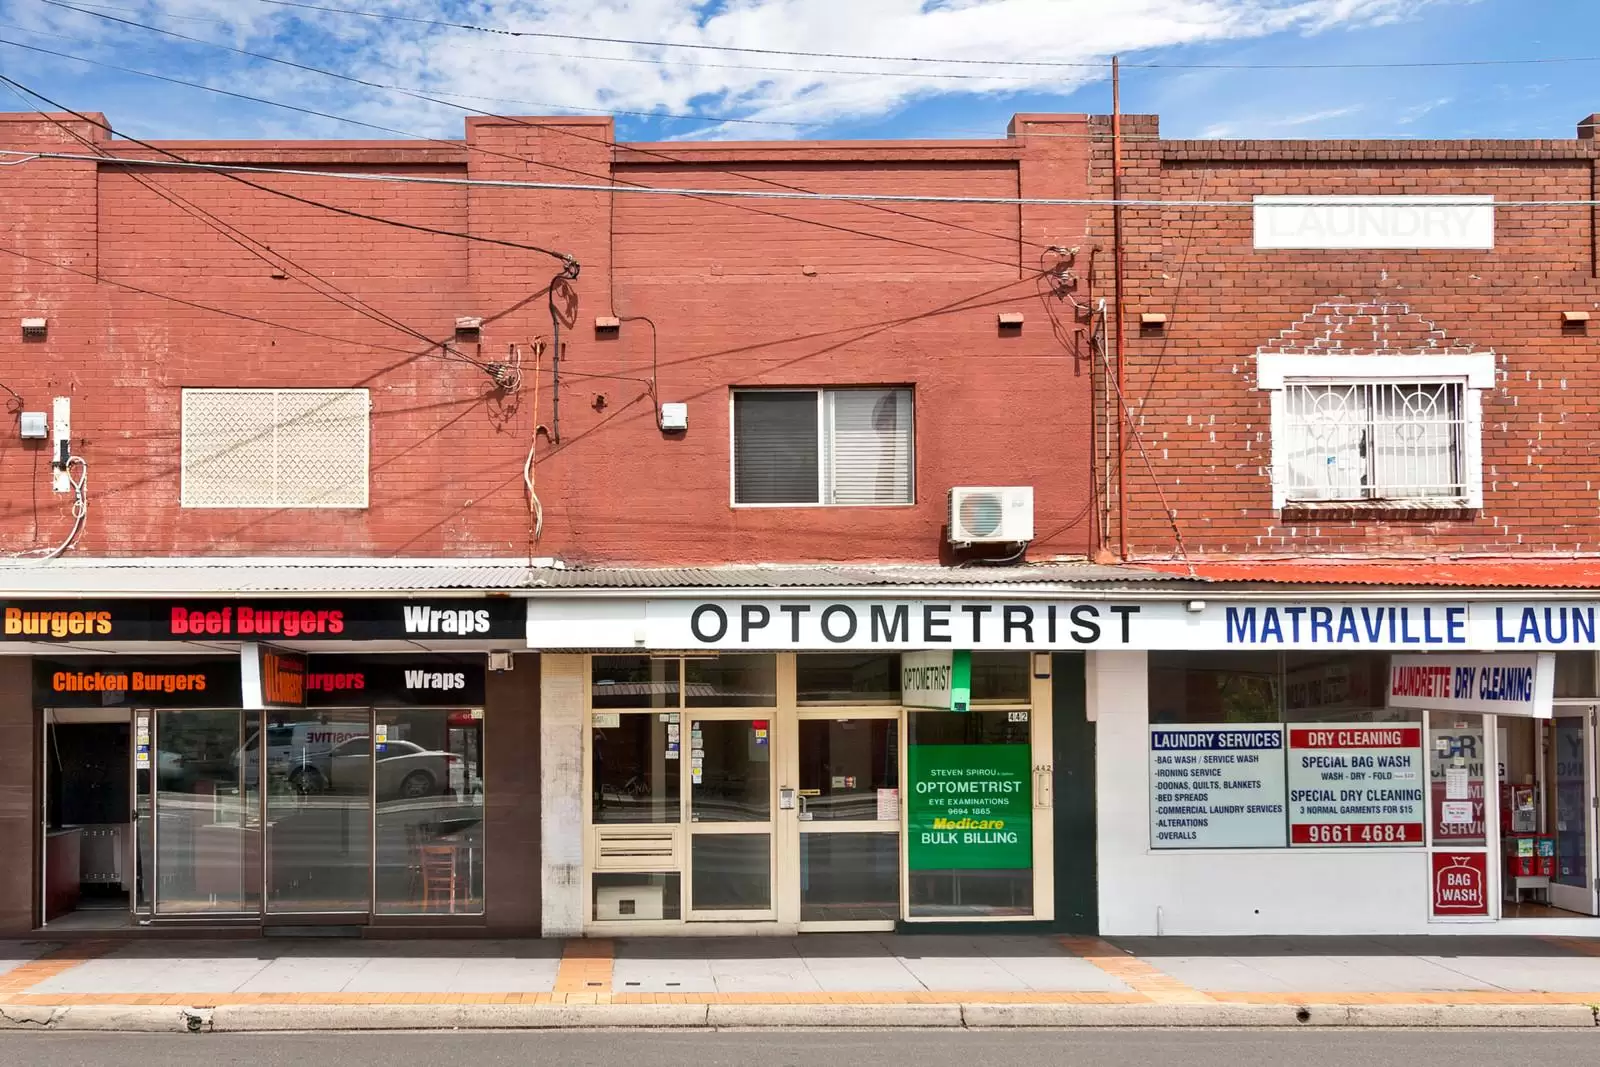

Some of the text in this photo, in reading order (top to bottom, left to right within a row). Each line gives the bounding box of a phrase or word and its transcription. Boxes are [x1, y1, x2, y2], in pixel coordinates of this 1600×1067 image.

[1270, 207, 1475, 237] LAUNDRY
[5, 607, 112, 637] Burgers
[171, 607, 344, 636] Beef Burgers
[403, 606, 490, 635] Wraps
[691, 603, 1141, 643] OPTOMETRIST
[1226, 607, 1595, 643] MATRAVILLE LAUN
[53, 672, 206, 693] Chicken Burgers
[305, 673, 365, 691] urgers
[404, 670, 465, 690] Wraps
[904, 665, 951, 691] OPTOMETRIST
[1392, 666, 1532, 701] LAUNDRETTE DRY CLEANING
[1008, 712, 1028, 722] 442
[1154, 733, 1280, 748] LAUNDRY SERVICES
[1308, 731, 1402, 746] DRY CLEANING
[1438, 735, 1484, 759] DR
[1174, 756, 1197, 764] WASH
[1203, 755, 1235, 764] SERVICE
[1237, 755, 1259, 763] WASH
[1302, 755, 1411, 768] SPECIAL BAG WASH
[1154, 768, 1222, 777] -IRONING SERVICE
[1321, 772, 1344, 780] WASH
[1350, 772, 1366, 780] DRY
[1373, 772, 1392, 780] FOLD
[916, 781, 1022, 793] OPTOMETRIST
[1192, 781, 1222, 790] QUILTS,
[1223, 780, 1262, 789] BLANKETS
[1155, 793, 1208, 802] -BED SPREADS
[1291, 789, 1422, 802] SPECIAL DRY CLEANING
[1155, 805, 1283, 815] -COMMERCIAL LAUNDRY SERVICES
[1300, 806, 1305, 814] 3
[1306, 806, 1338, 814] NORMAL
[1340, 806, 1381, 814] GARMENTS
[1400, 805, 1413, 814] $15
[933, 818, 1004, 829] Medicare
[1155, 819, 1209, 827] -ALTERATIONS
[921, 832, 1018, 844] BULK BILLING
[1156, 832, 1197, 840] -OVERALLS
[1309, 825, 1406, 842] 9661 4684
[1447, 873, 1471, 886] BAG
[1442, 888, 1477, 901] WASH
